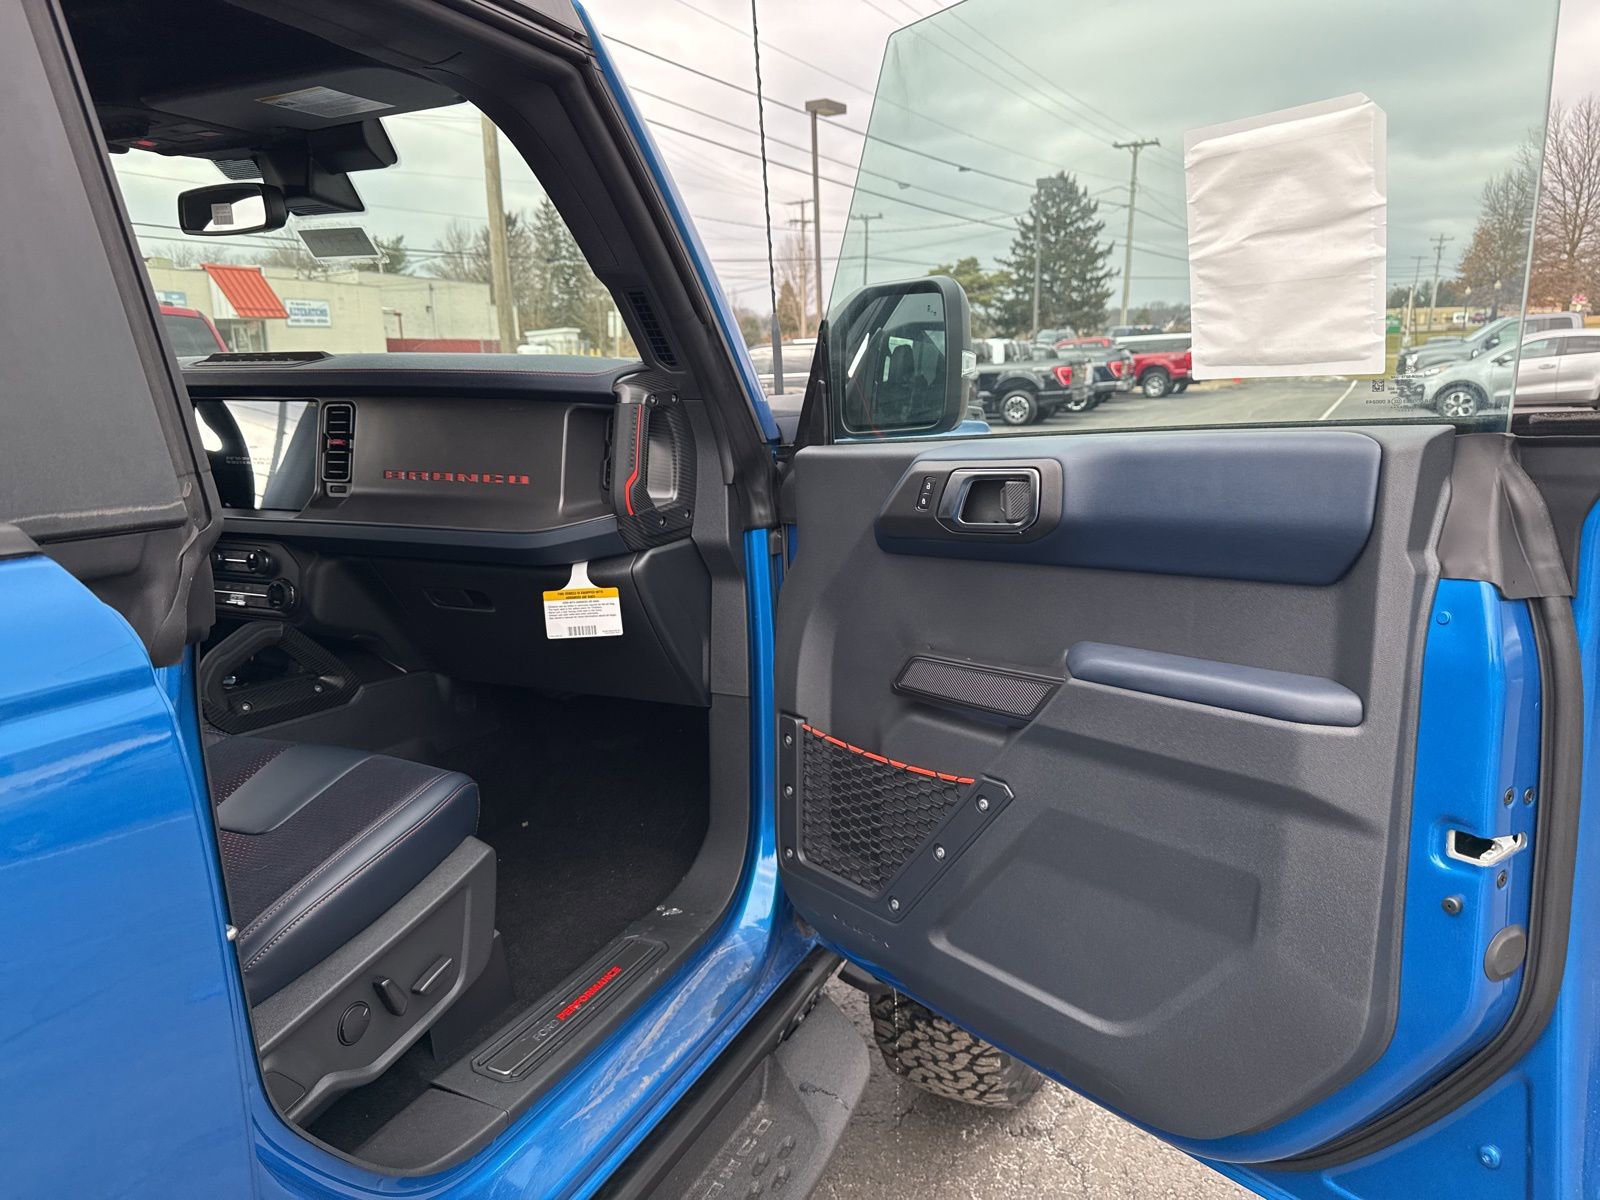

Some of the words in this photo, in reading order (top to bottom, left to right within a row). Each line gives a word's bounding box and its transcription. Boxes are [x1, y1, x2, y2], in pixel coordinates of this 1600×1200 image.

[384, 470, 530, 485] BRONCO
[533, 1019, 560, 1041] FORD
[556, 966, 622, 1020] PERFORMANCE
